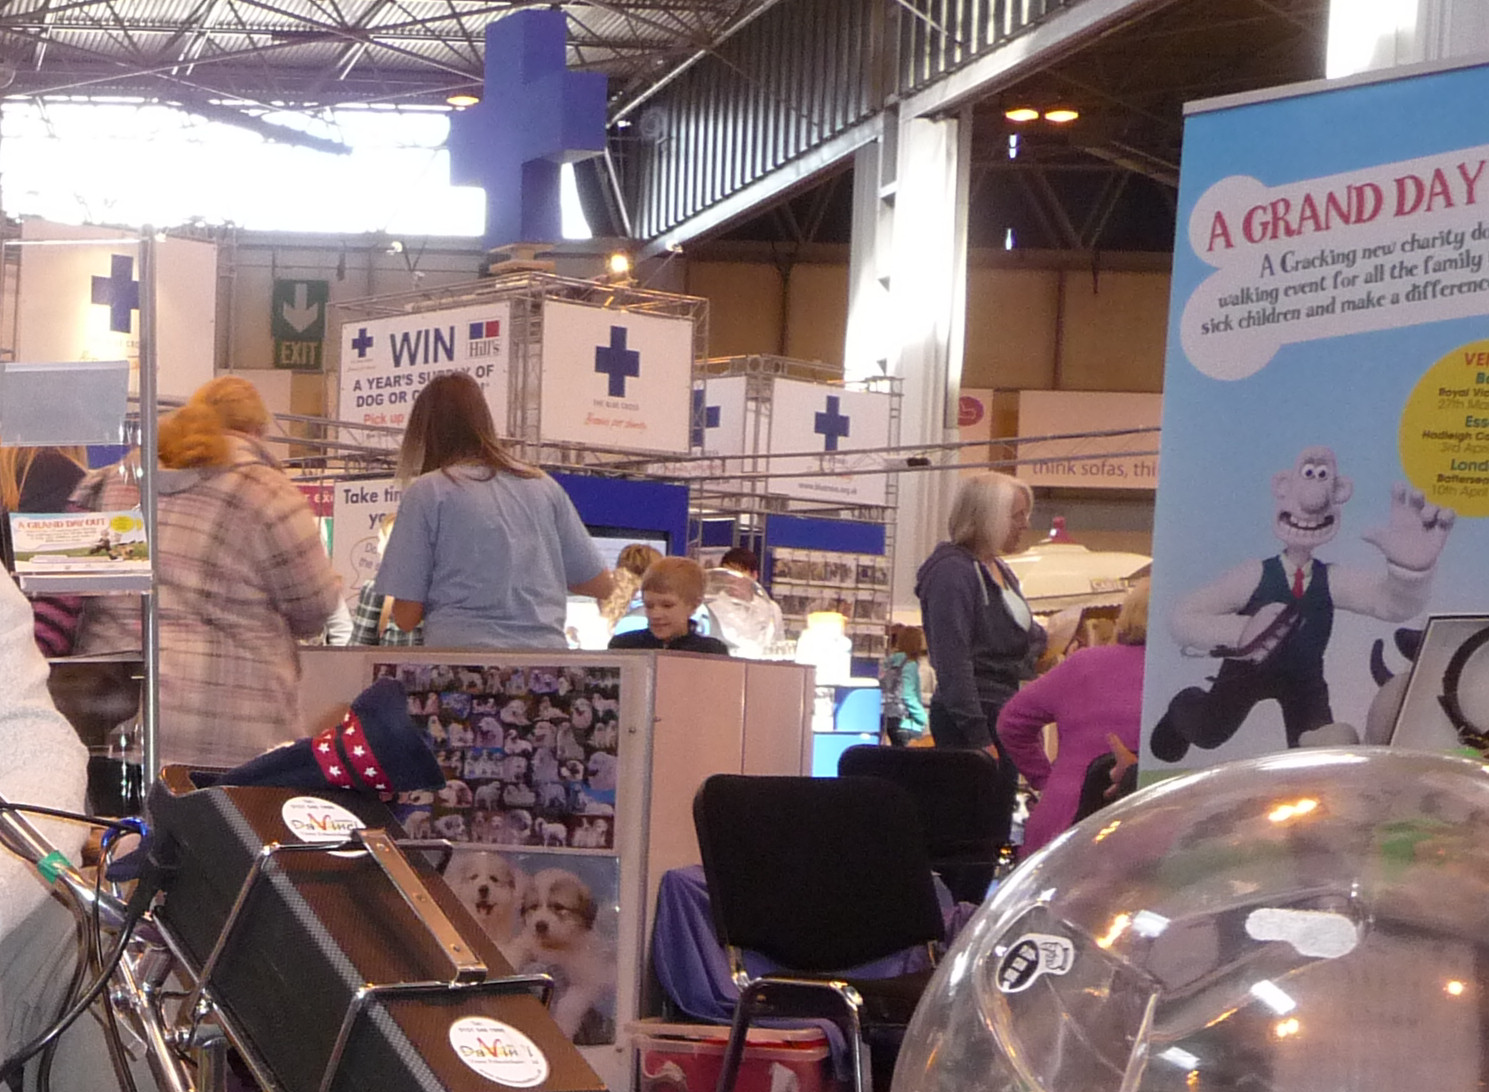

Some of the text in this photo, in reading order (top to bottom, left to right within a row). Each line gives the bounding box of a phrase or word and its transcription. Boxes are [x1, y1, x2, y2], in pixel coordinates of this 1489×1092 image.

[1206, 160, 1486, 251] A GRAND DAY
[1260, 254, 1274, 278] A
[1280, 247, 1357, 274] Cracking
[1362, 241, 1397, 260] new
[1401, 227, 1466, 251] charity
[1219, 249, 1483, 308] walking event for all the family
[1201, 278, 1489, 335] sick children and make a differenc
[281, 342, 318, 365] EXIT
[390, 325, 500, 368] WIN Hill's
[353, 379, 362, 392] A
[367, 373, 413, 390] YEAR'S
[475, 364, 495, 378] OF
[356, 391, 384, 408] DOG
[388, 390, 407, 404] OR
[363, 413, 405, 425] Pick up
[1081, 459, 1129, 478] sofas,
[344, 486, 378, 504] Take
